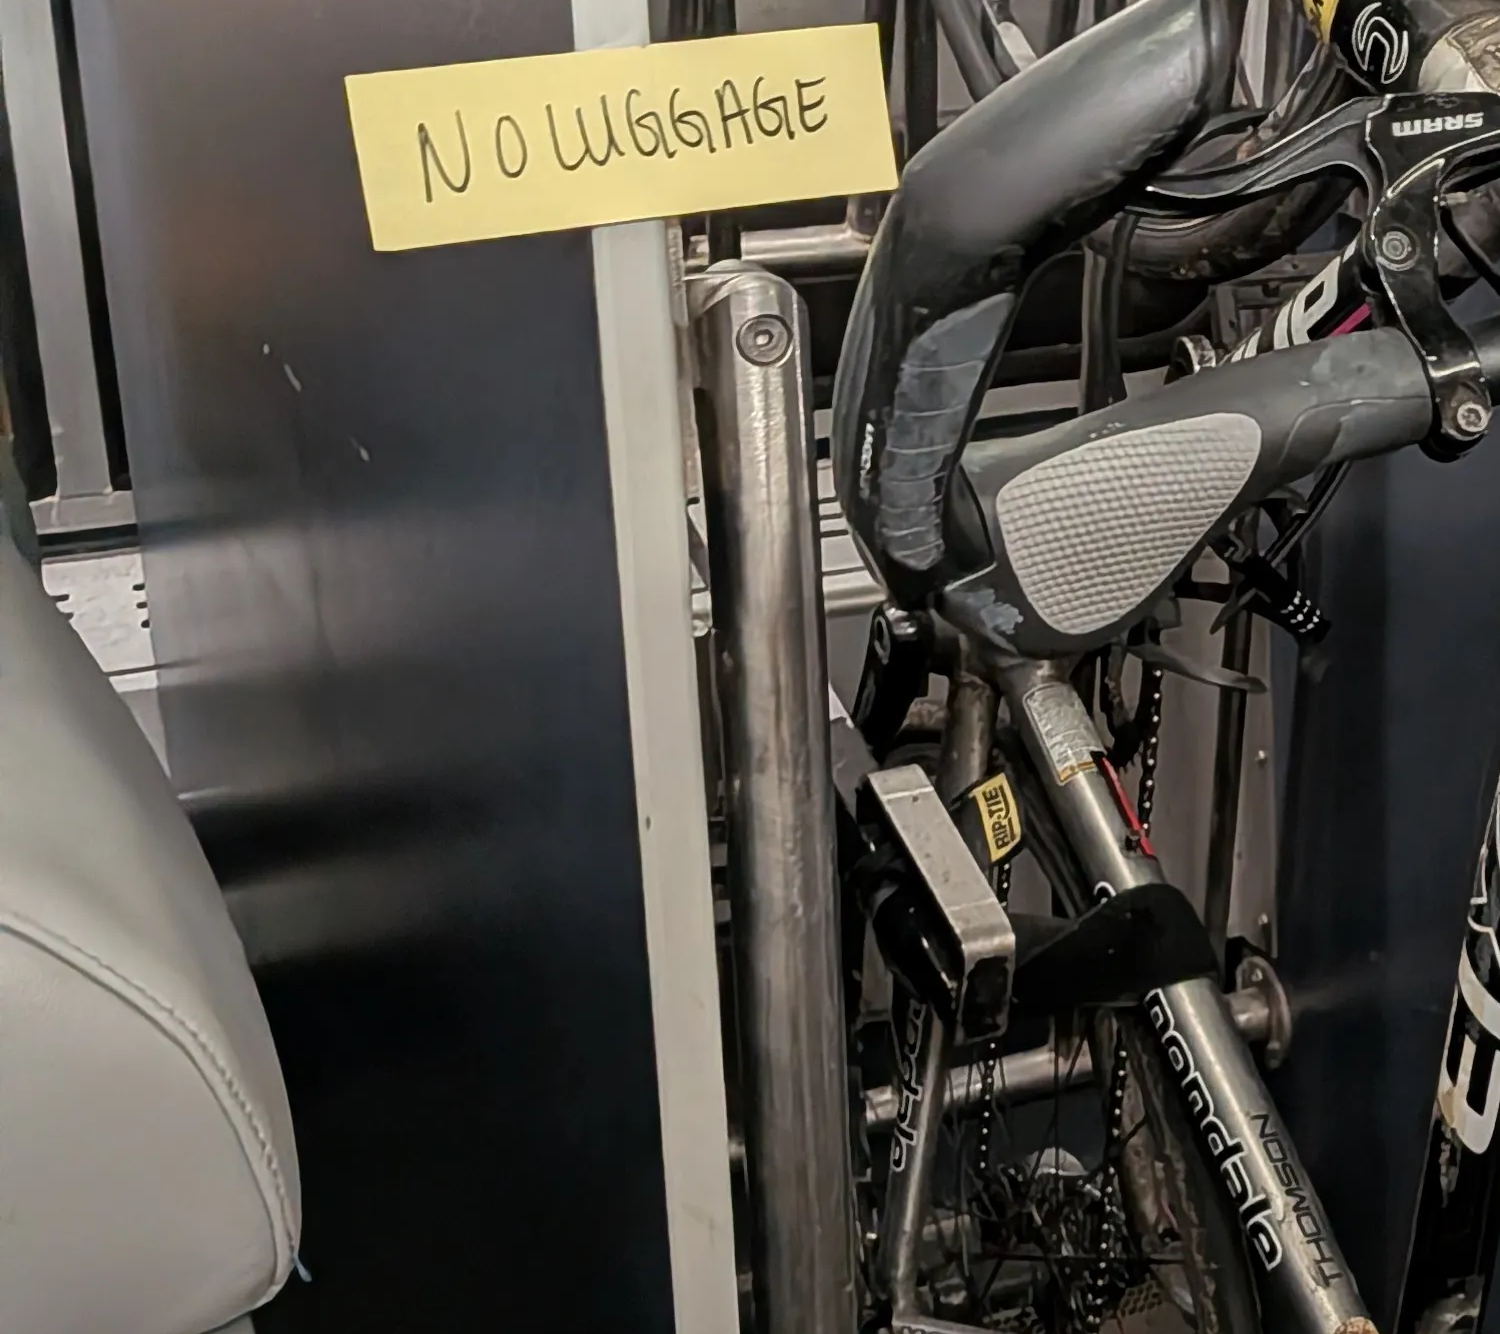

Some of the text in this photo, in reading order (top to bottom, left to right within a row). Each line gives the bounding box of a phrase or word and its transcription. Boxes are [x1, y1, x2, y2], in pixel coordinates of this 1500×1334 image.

[417, 76, 829, 203] NO LUGGAGE
[1391, 111, 1485, 138] SRAM
[1252, 1113, 1344, 1288] THOMSON
